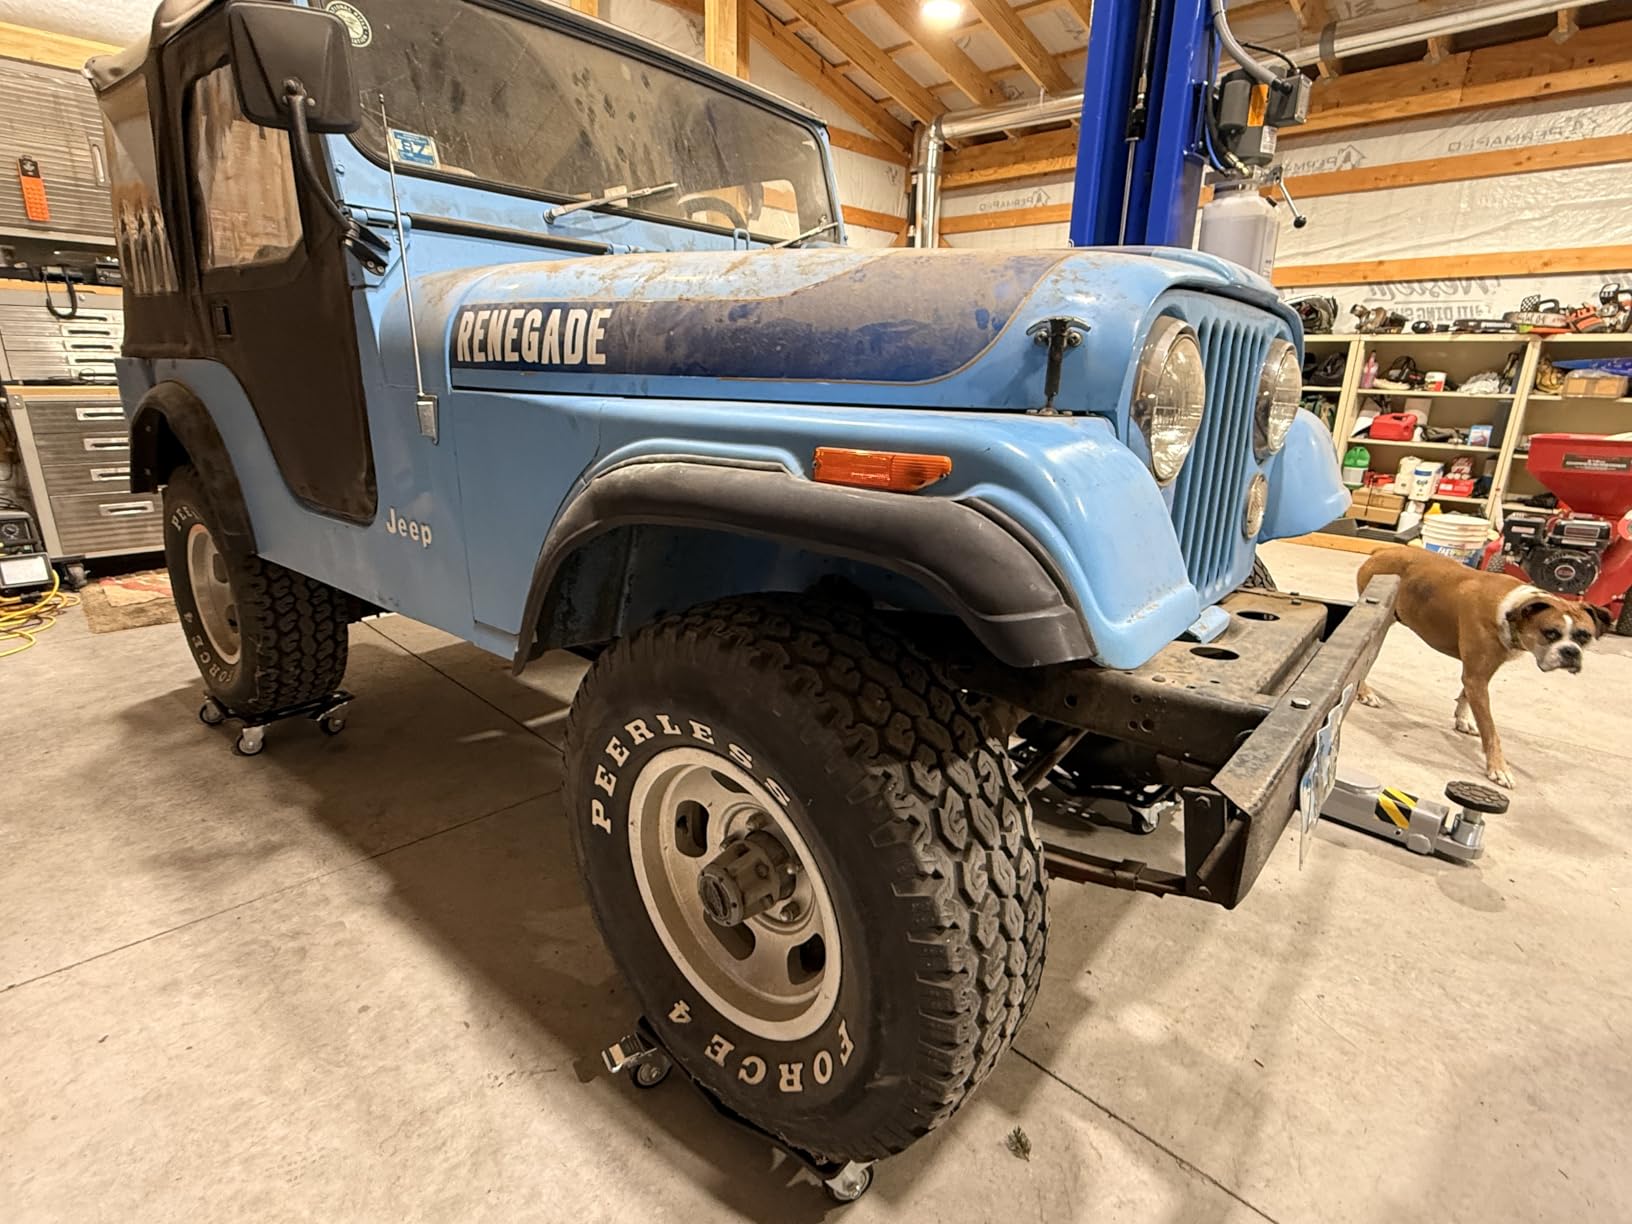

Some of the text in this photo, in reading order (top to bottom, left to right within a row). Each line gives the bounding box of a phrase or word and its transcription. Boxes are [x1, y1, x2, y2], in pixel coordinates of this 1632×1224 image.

[457, 308, 613, 364] RENEGADE
[385, 507, 432, 548] Jeep
[591, 714, 790, 834] PEERLESS
[668, 1000, 854, 1093] FORCE 4
